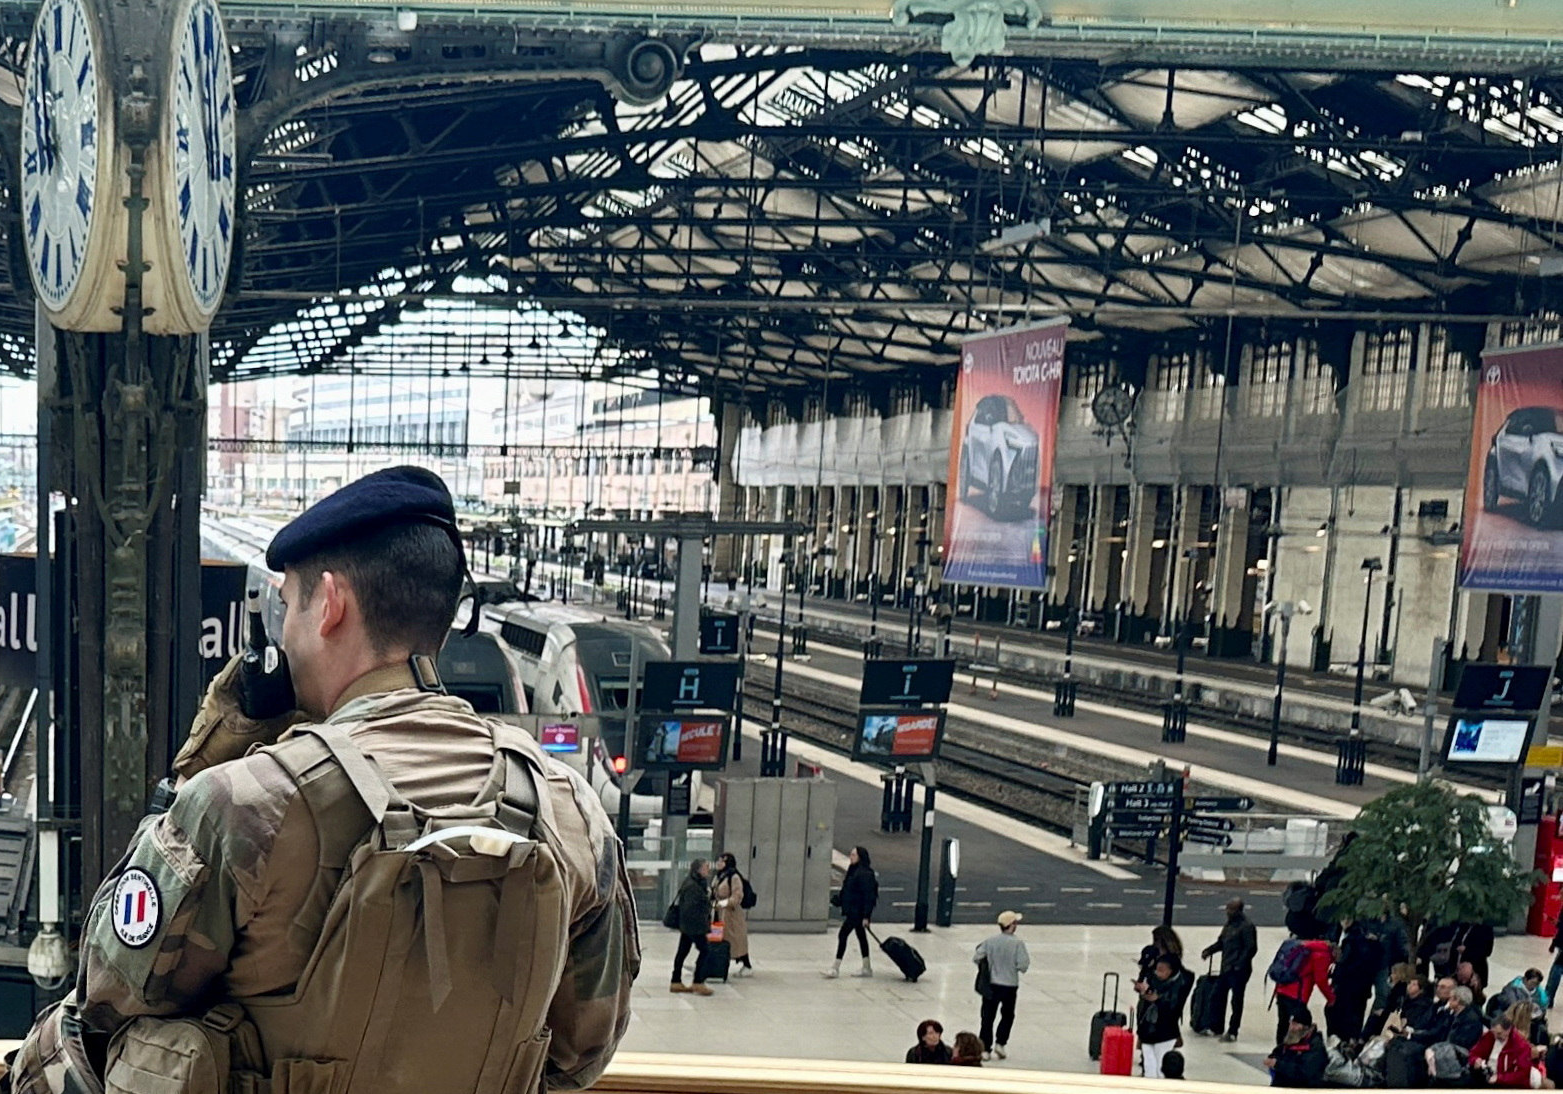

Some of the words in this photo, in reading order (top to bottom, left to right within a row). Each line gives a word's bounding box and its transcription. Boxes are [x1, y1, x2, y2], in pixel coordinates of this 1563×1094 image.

[1025, 337, 1064, 361] NOUVEAU
[1013, 363, 1040, 385] TOYOTA
[678, 677, 700, 700] H
[1492, 679, 1511, 700] J
[1121, 784, 1138, 793] Hall
[1139, 784, 1145, 793] 2
[1125, 798, 1143, 807] Hall
